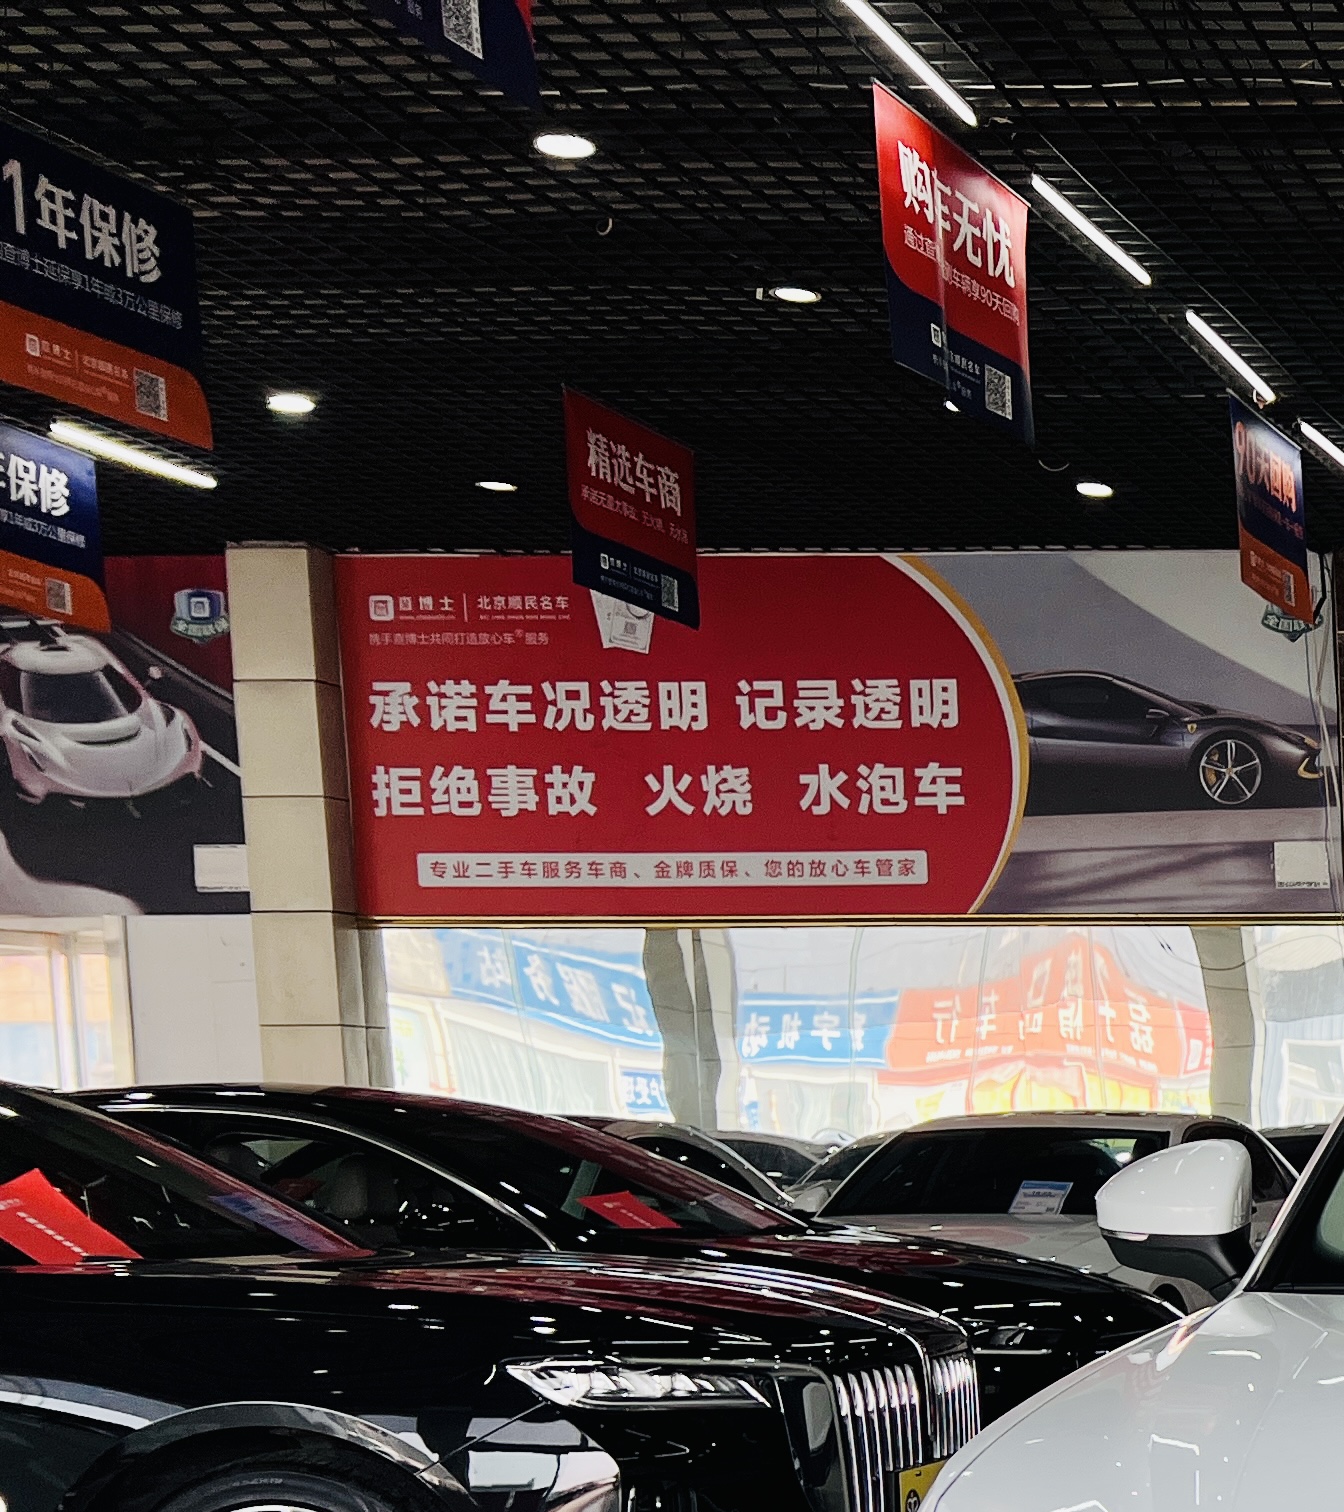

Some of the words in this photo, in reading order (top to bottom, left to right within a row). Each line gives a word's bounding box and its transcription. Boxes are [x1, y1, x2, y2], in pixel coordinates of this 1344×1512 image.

[2, 158, 162, 283] 1年保修
[897, 139, 1016, 289] 购车无忧
[0, 452, 70, 518] 保修
[585, 427, 682, 518] 精选车商
[477, 595, 570, 611] 北京顺民名车
[368, 680, 709, 732] 承诺车况透明
[734, 678, 960, 730] 记录透明
[371, 764, 598, 817] 拒绝事故
[644, 764, 753, 816] 火烧
[798, 763, 966, 815] 水泡车
[429, 857, 918, 881] 专业二手车服务车商、金牌质保、您的放心车管家
